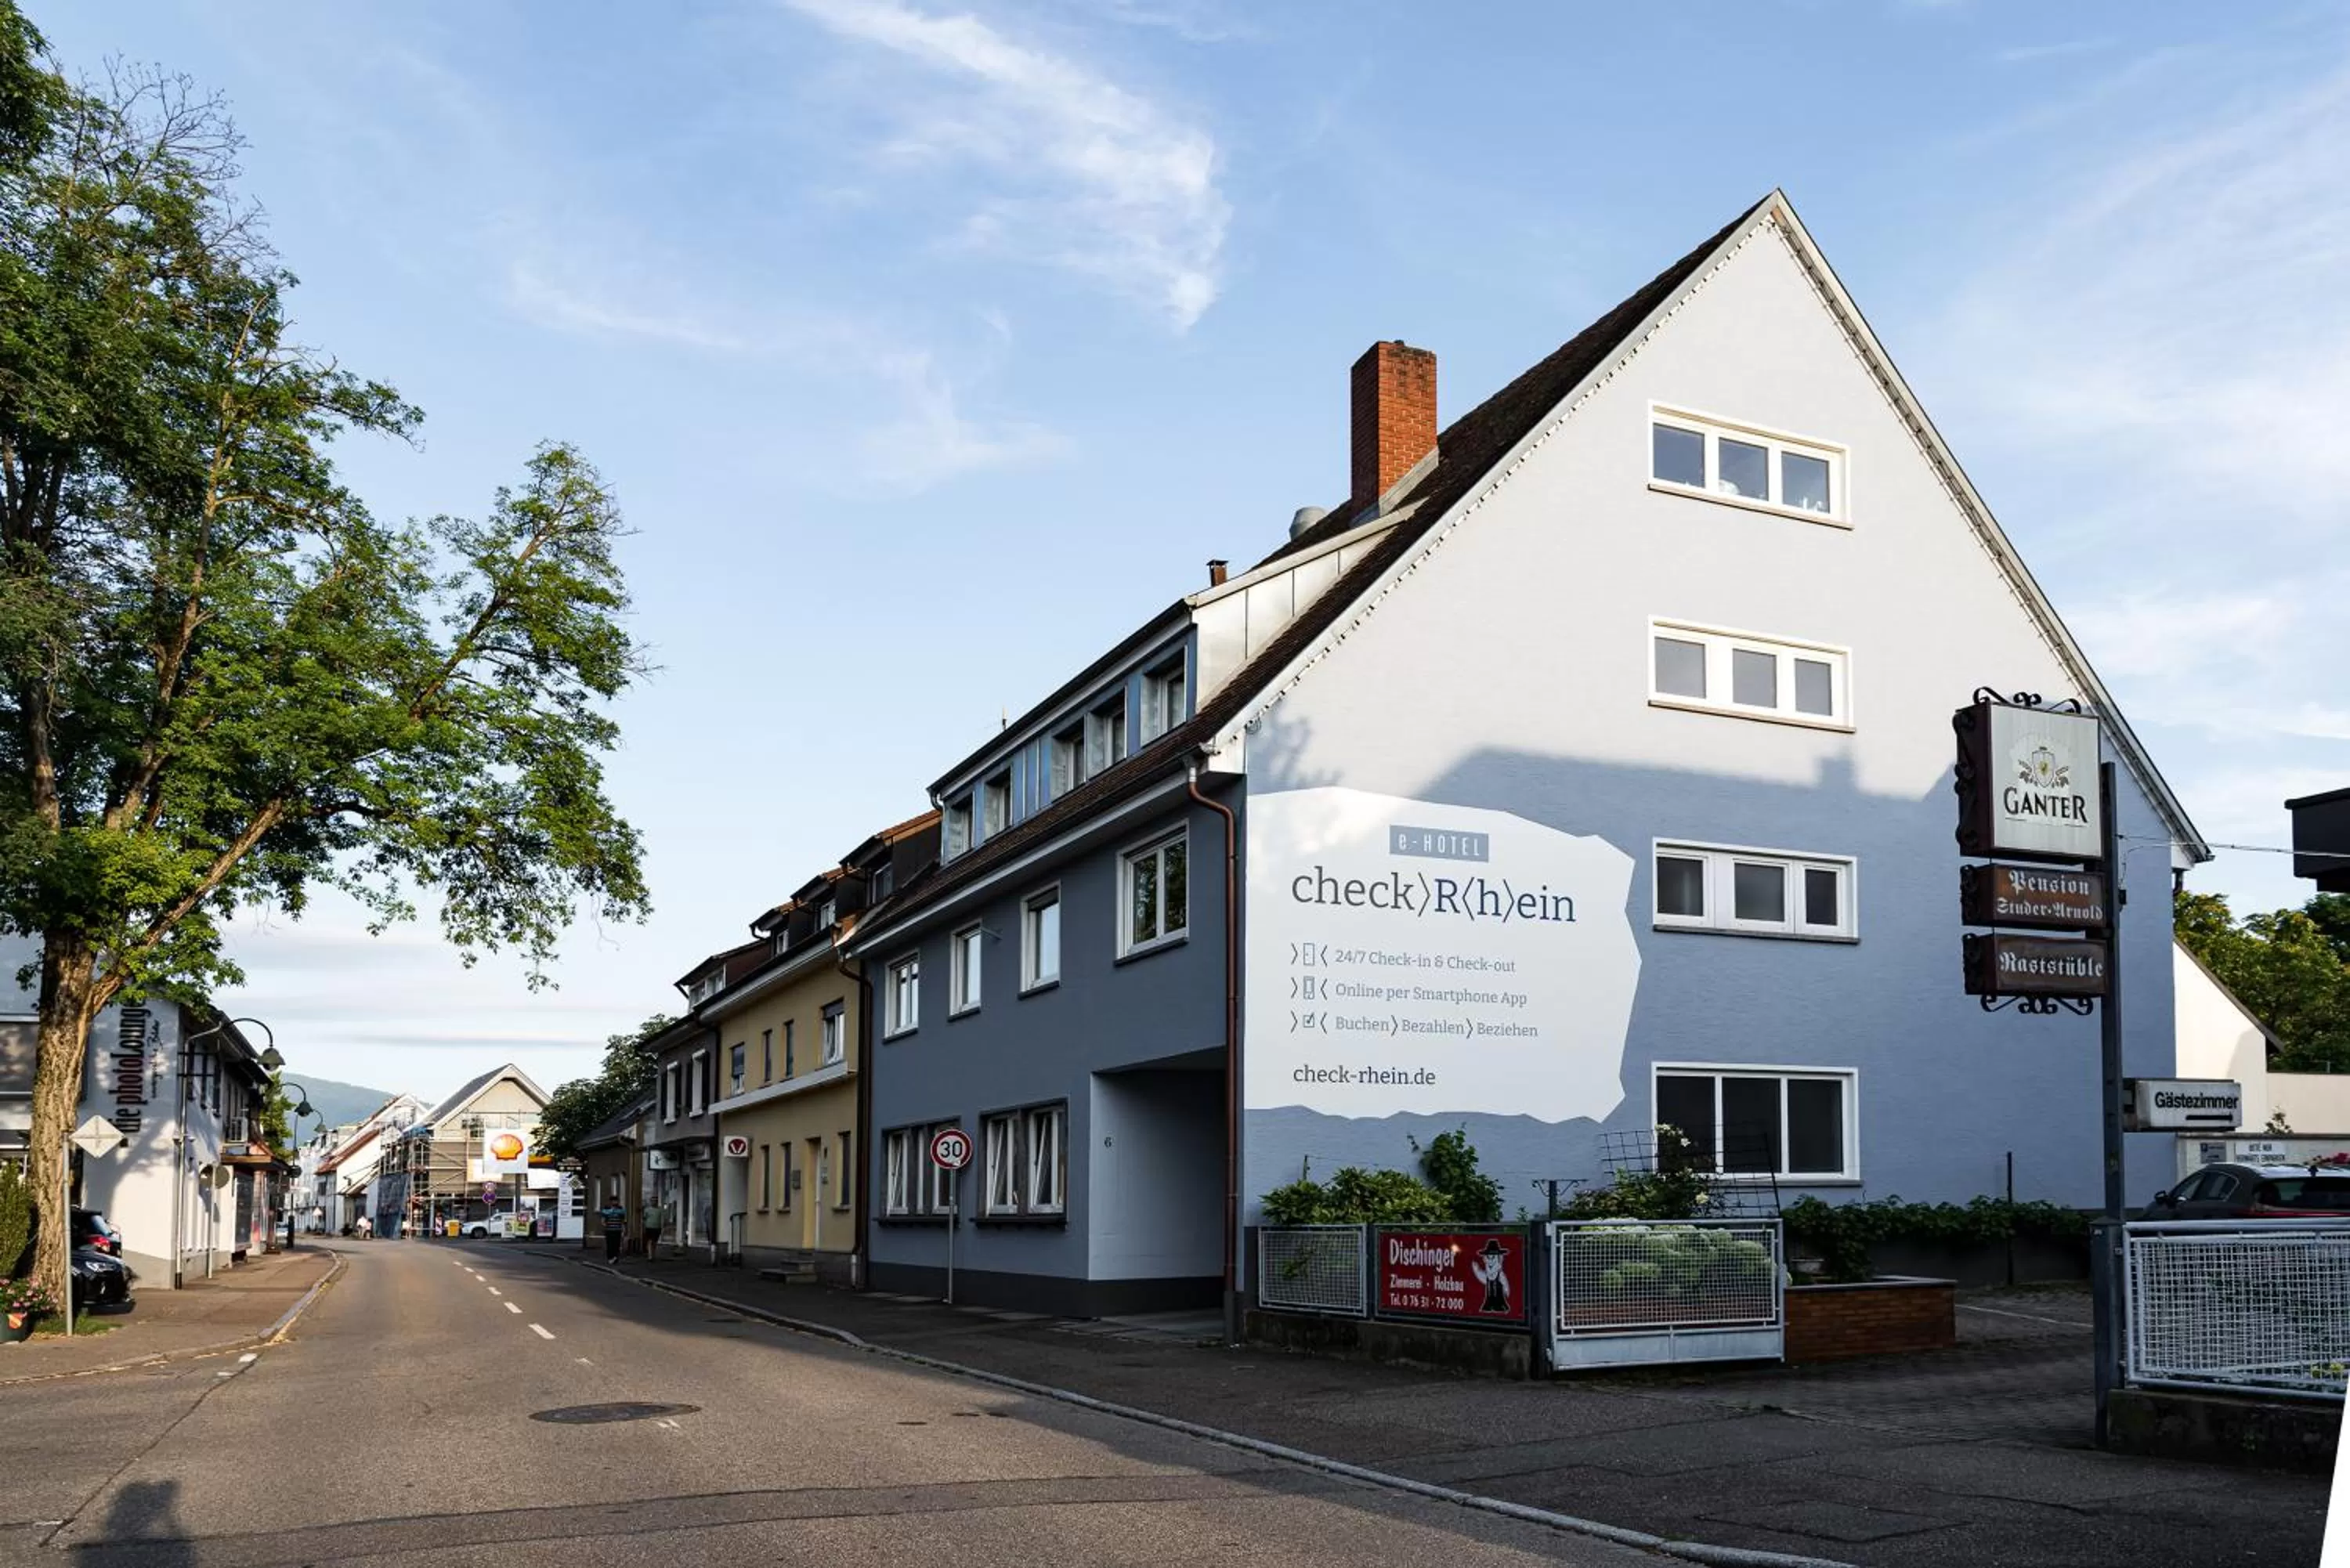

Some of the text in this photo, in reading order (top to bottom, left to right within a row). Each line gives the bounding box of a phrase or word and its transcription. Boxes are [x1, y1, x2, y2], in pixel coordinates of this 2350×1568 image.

[2003, 786, 2088, 823] GANTER
[1398, 832, 1480, 856] e-HOTEL
[2008, 869, 2090, 896] Pension
[1335, 950, 1517, 972] 24/7 Check-in & Check-out
[1999, 952, 2103, 977] Raststüble
[1336, 984, 1528, 1008] Online per Smartphone App
[1336, 1016, 1539, 1037] Buchen Bezahlen Beziehen
[1293, 1064, 1437, 1086] check-rhein.de
[2155, 1091, 2240, 1110] Gästezimmer
[940, 1140, 964, 1158] 30
[1390, 1238, 1455, 1273] Dischinger
[1434, 1276, 1464, 1292] Holzbau
[1436, 1296, 1446, 1309] 72
